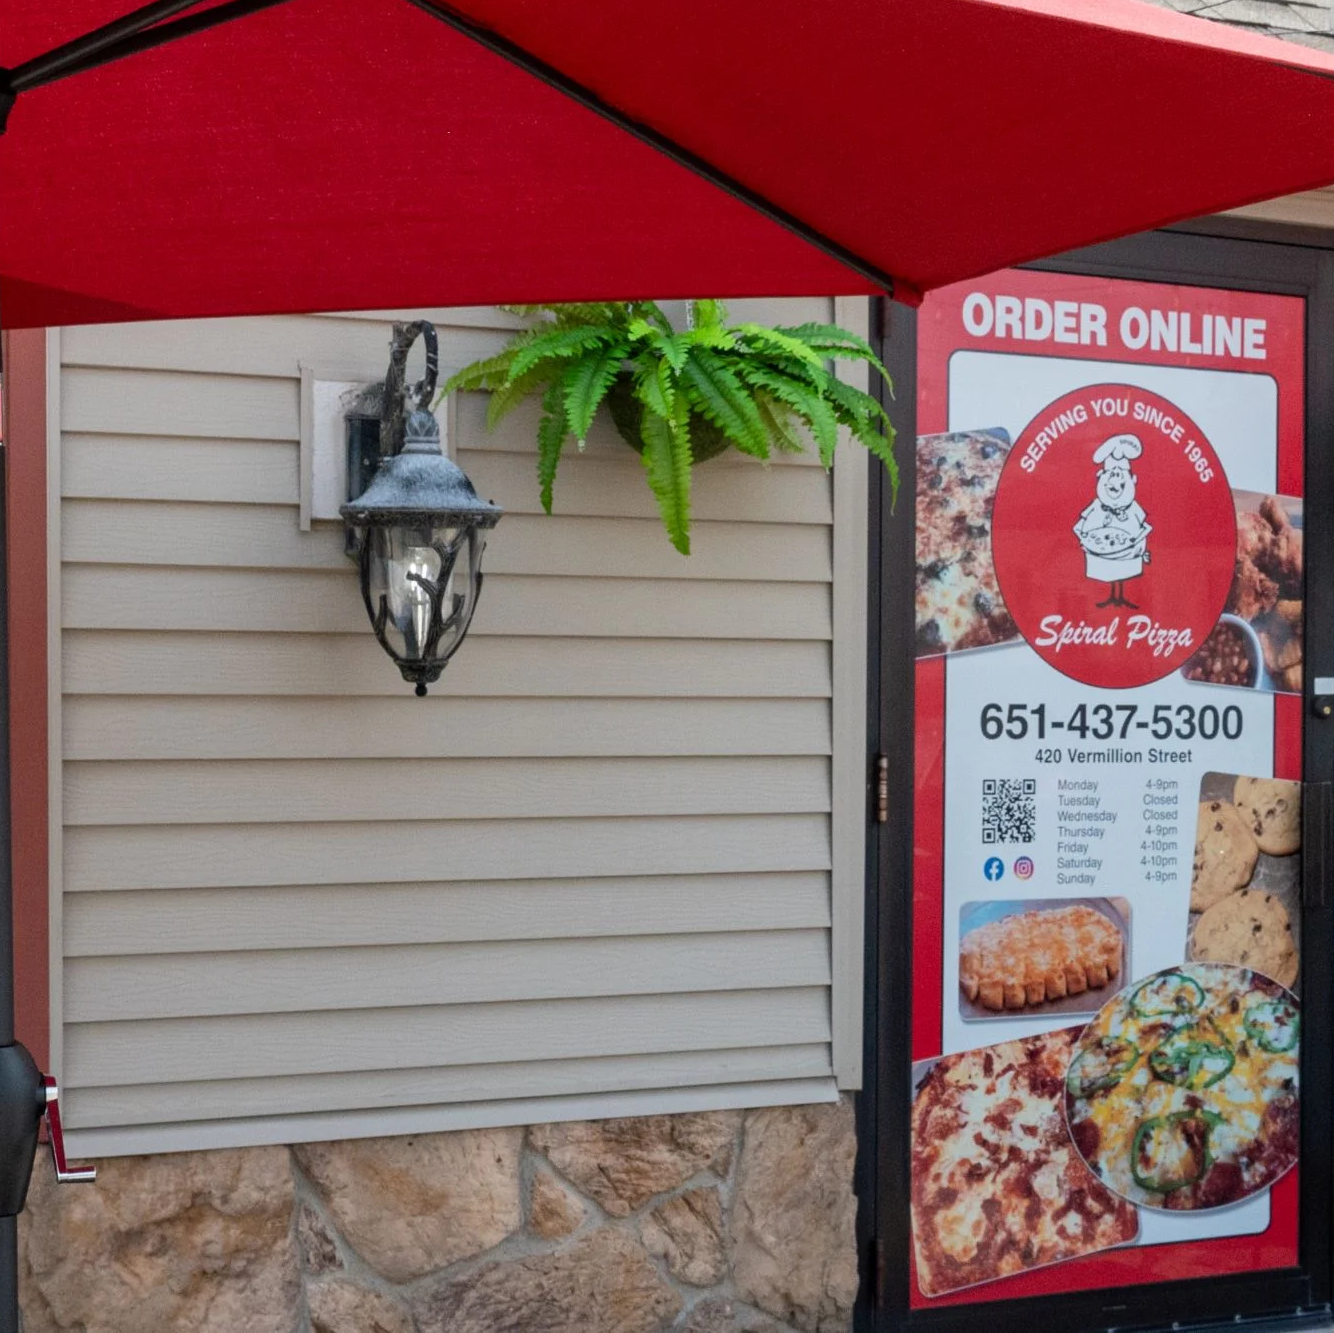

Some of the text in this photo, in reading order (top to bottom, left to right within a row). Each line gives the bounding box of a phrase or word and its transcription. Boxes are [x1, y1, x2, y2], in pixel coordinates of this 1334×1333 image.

[962, 292, 1266, 359] ORDER ONLINE
[1020, 398, 1214, 483] SERVING YOU SINCE 1965
[1035, 615, 1194, 657] Spiral Pizza
[980, 703, 1244, 740] 651-437-5300
[1035, 748, 1192, 763] 420 Vermillion Street
[1057, 778, 1178, 793] Monday 4-9pm
[1058, 793, 1178, 808] Tuesday Closed
[1057, 809, 1178, 824] Wednesday Closed
[1057, 824, 1178, 839] Thursday 4-9pm
[1057, 840, 1178, 855] Friday 4-10pm
[1057, 855, 1177, 871] Saturday 4-10pm
[1057, 871, 1177, 886] Sunday 4-9pm
